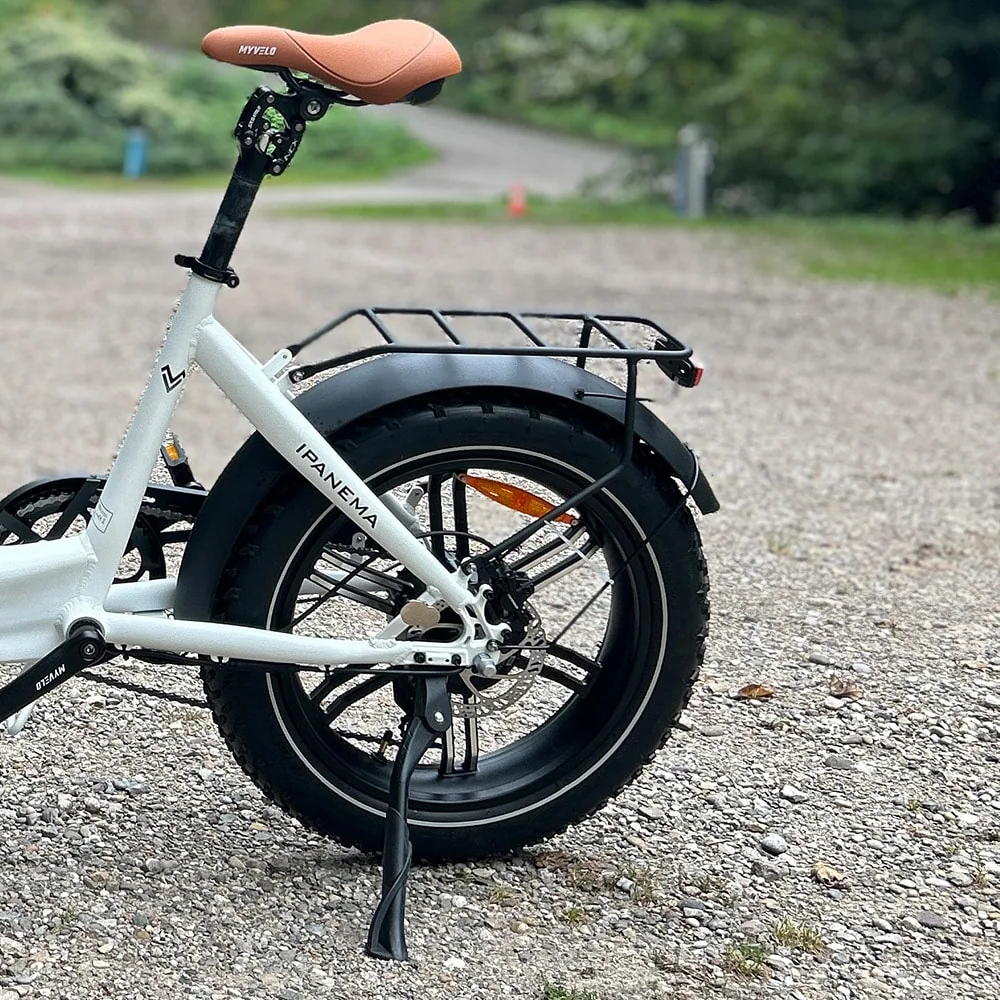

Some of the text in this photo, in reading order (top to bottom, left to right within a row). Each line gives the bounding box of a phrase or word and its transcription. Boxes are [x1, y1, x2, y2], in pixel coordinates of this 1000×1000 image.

[239, 45, 277, 56] MYVELO
[295, 443, 378, 529] IPANEMA
[35, 663, 66, 691] MYVELO
